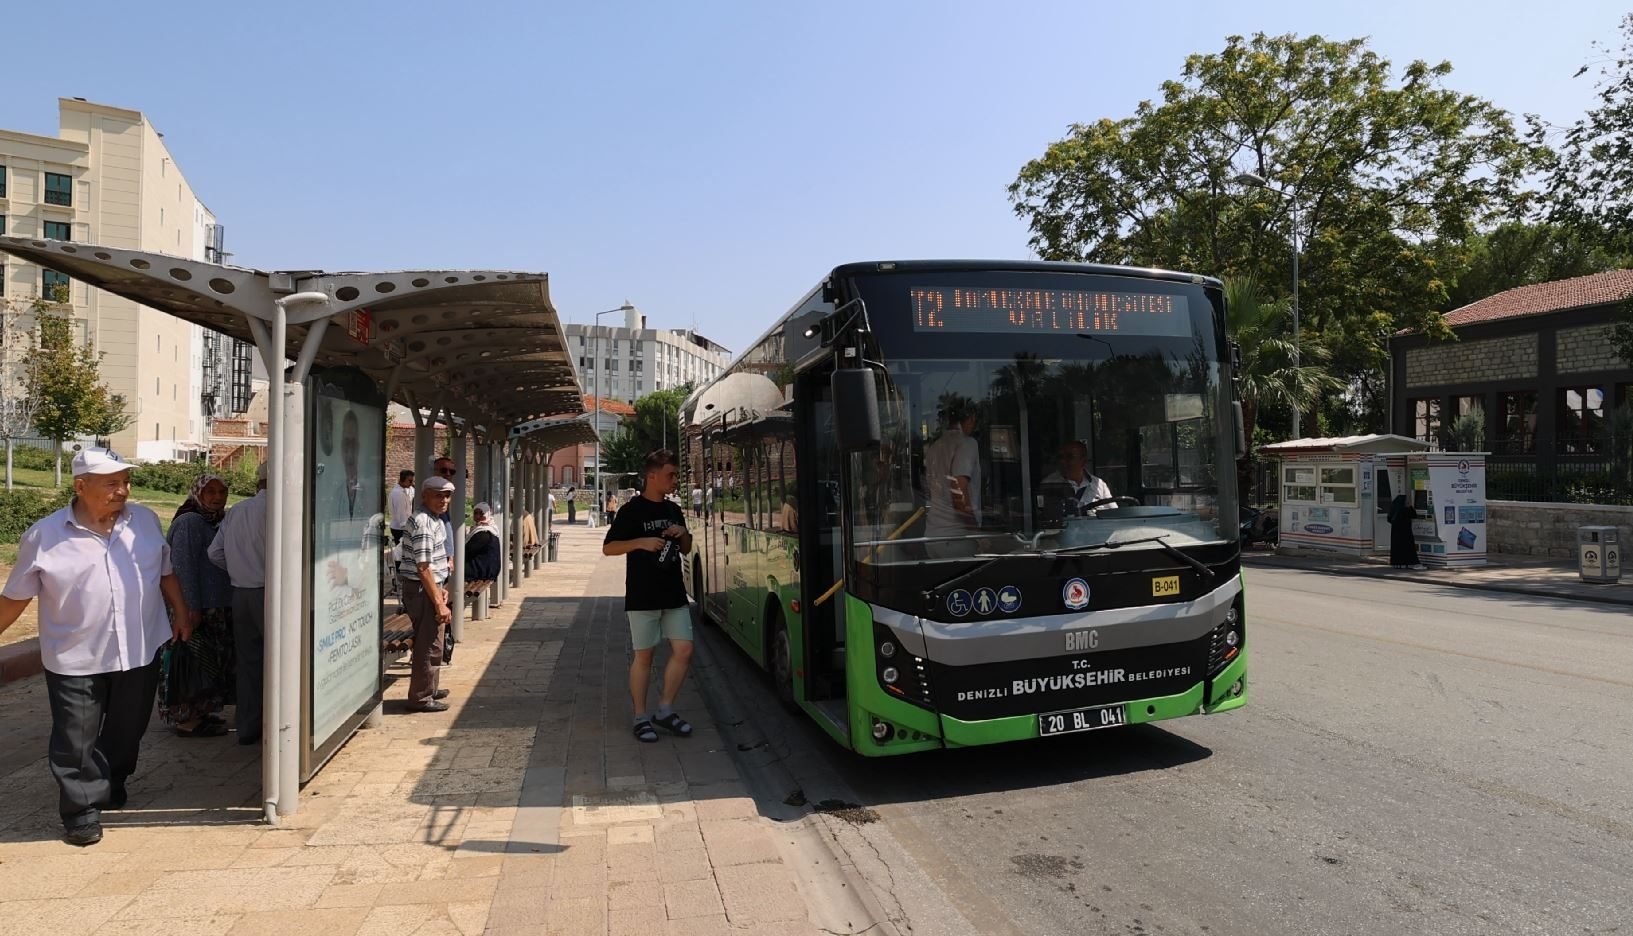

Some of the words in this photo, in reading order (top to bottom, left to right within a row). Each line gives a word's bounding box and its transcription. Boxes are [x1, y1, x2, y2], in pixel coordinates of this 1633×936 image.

[1155, 579, 1178, 593] B-041
[1065, 630, 1099, 651] BMC
[1072, 659, 1091, 669] T.C.
[957, 687, 1008, 702] DENİZLİ
[1012, 668, 1126, 695] BÜYÜKŞEHİR
[1128, 665, 1192, 682] BELEDİYESİ
[1048, 715, 1065, 733] 20
[1073, 711, 1090, 729] BL
[1100, 706, 1124, 725] 041
